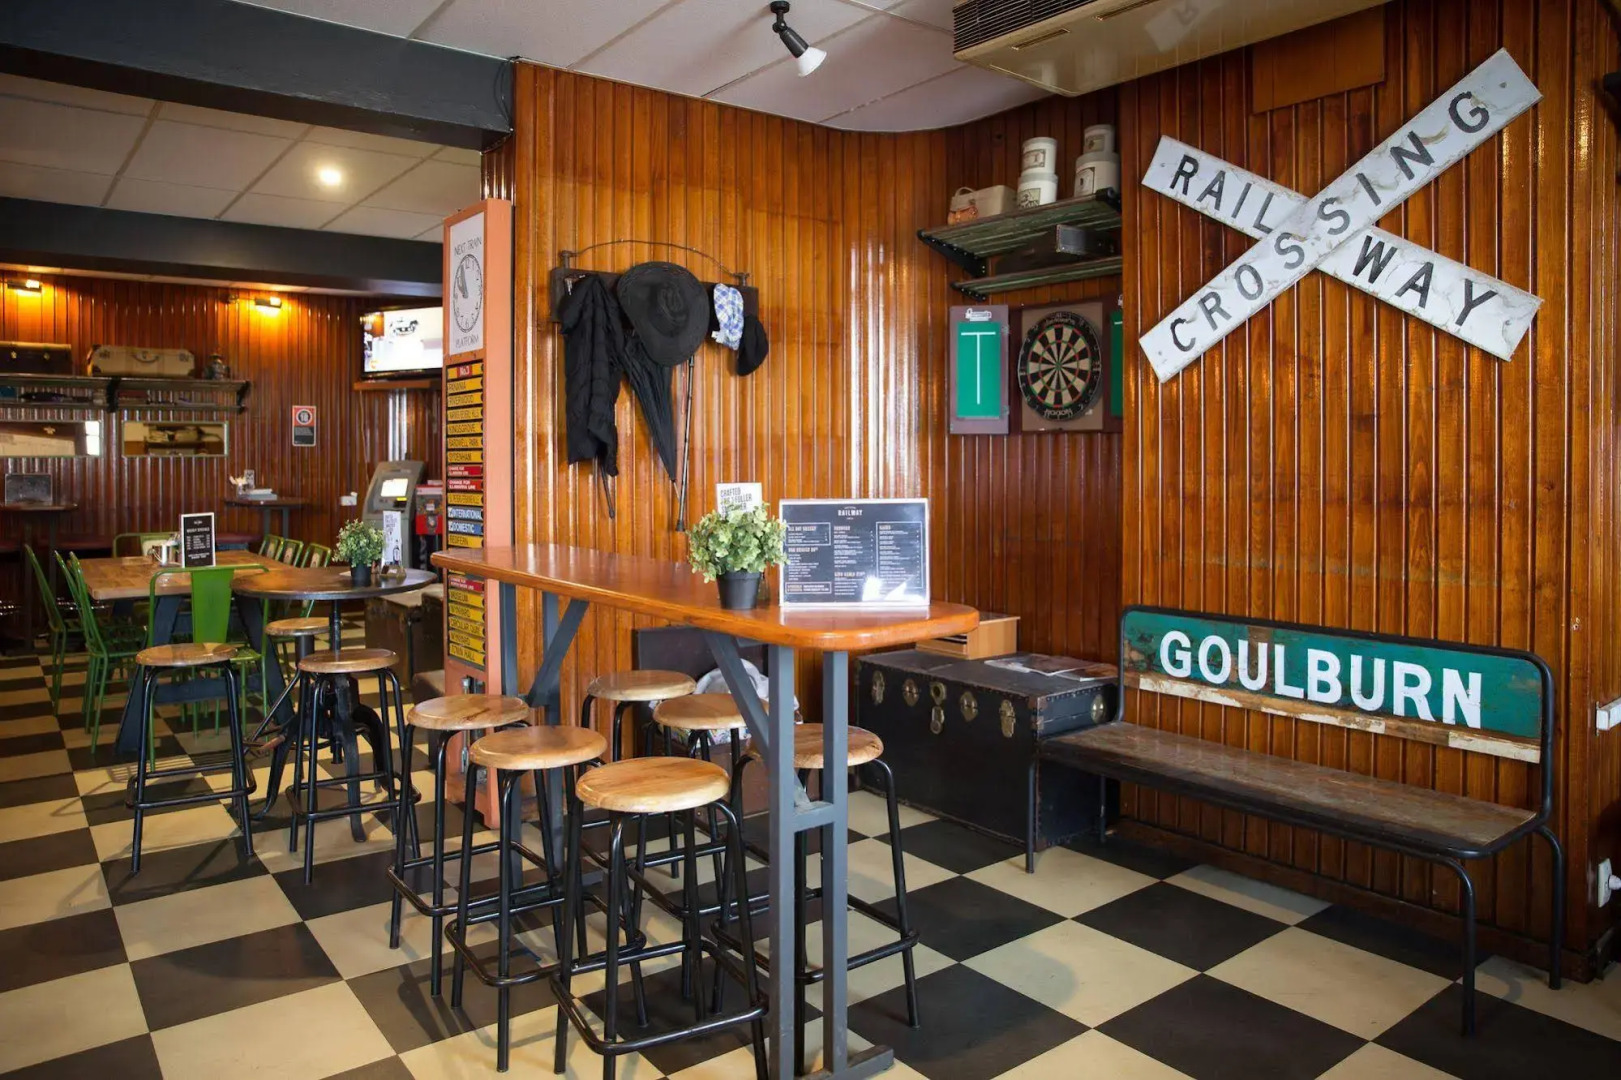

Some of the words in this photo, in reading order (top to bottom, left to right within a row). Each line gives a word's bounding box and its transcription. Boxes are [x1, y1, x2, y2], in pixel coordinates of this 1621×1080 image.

[1170, 91, 1490, 353] CROSSING
[454, 242, 466, 256] NEXT
[468, 236, 482, 250] TRAIN
[455, 333, 479, 348] PLATFORM
[449, 423, 476, 434] KINGSGROVE
[449, 452, 472, 462] SYDENHAM
[720, 487, 741, 497] CRAFTED
[452, 522, 475, 533] DOMESTIC
[450, 535, 469, 545] REDFERN
[451, 591, 468, 602] MUSEUM
[451, 604, 470, 618] WYNYARD
[451, 618, 469, 631] CIRCULAR
[451, 644, 463, 657] TOWN
[464, 648, 475, 661] HALL
[1159, 630, 1482, 729] GOULBURN
